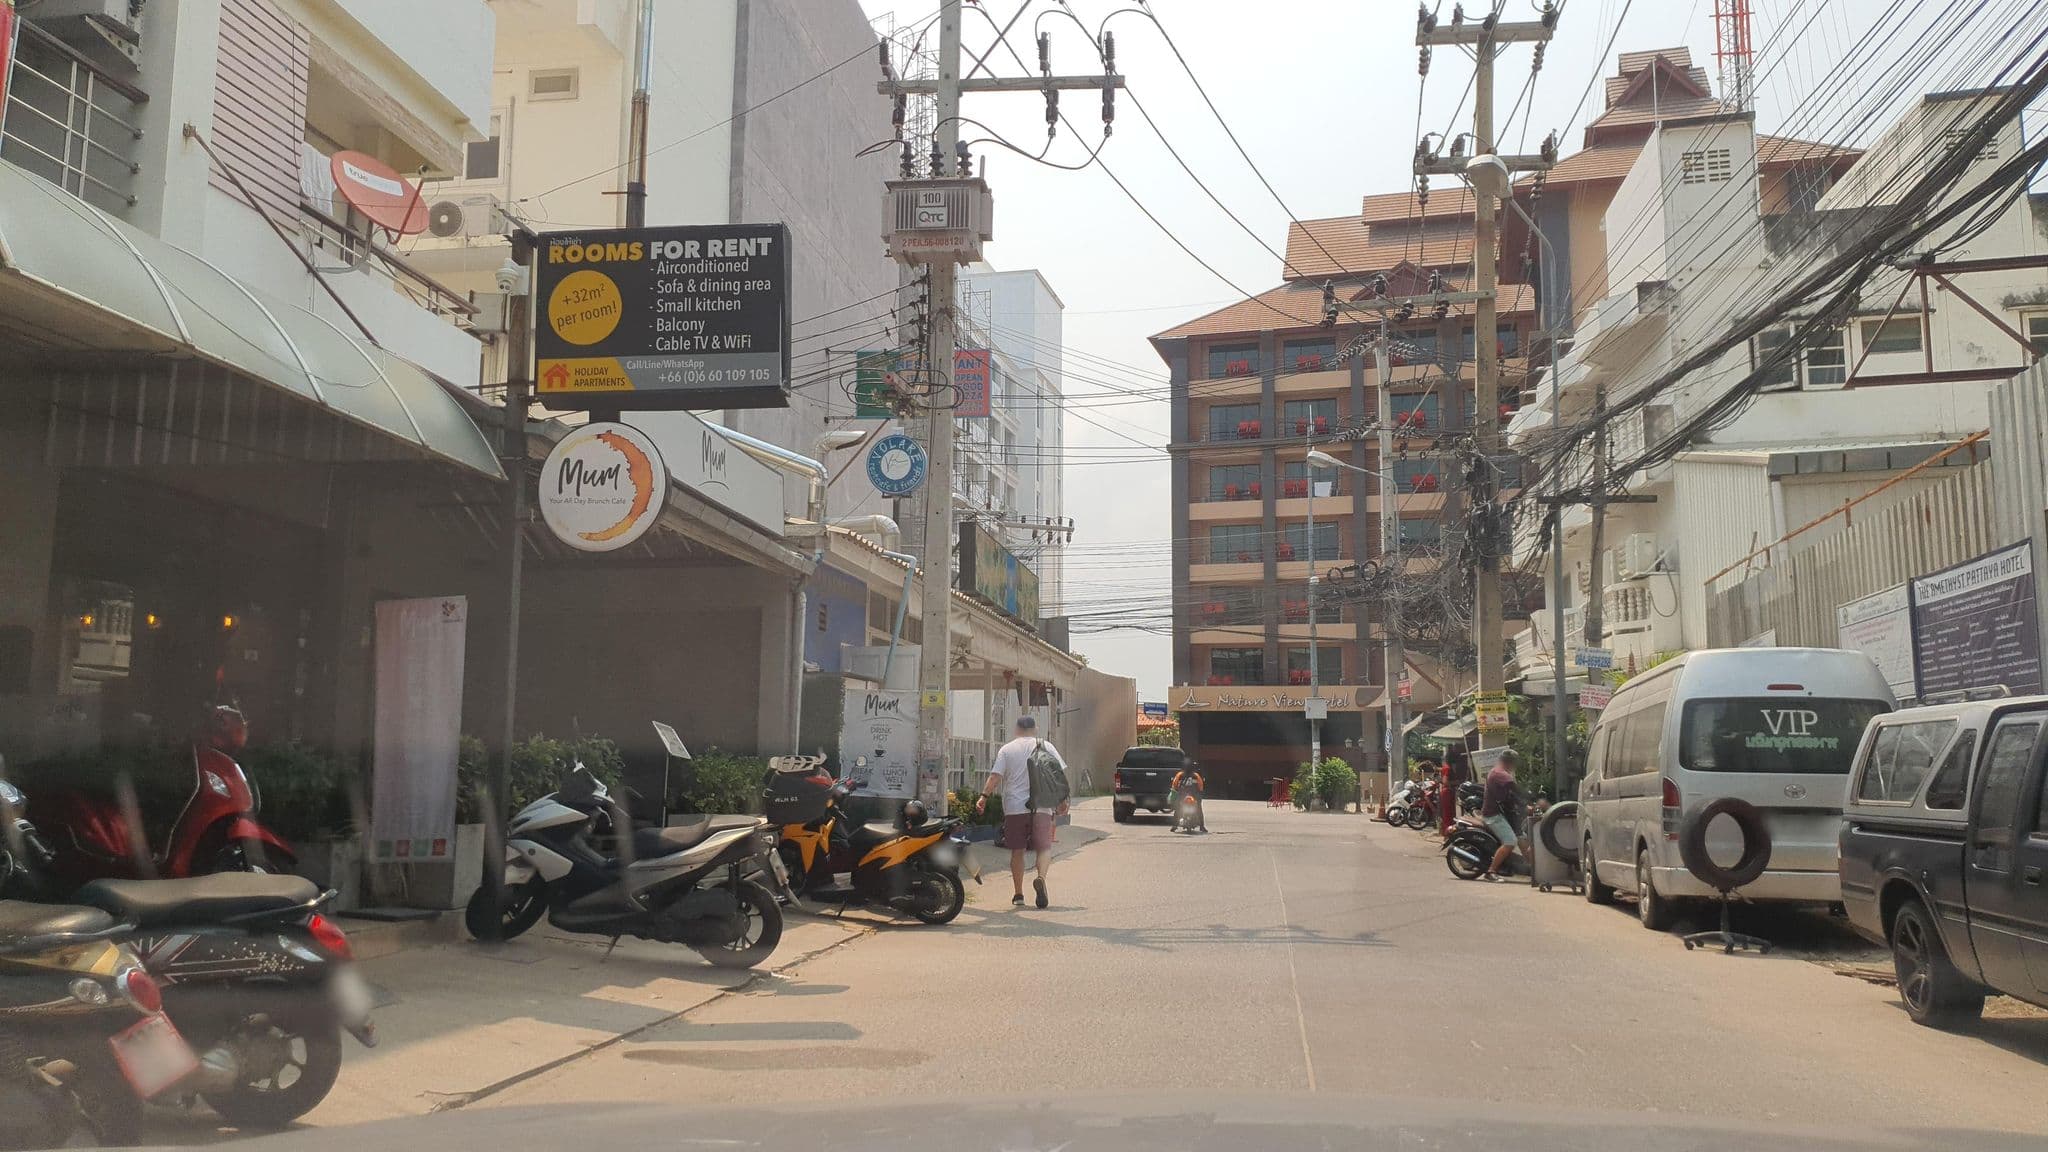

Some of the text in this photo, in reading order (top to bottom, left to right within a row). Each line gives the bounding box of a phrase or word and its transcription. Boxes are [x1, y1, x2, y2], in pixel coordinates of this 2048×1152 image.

[923, 192, 941, 204] 100
[918, 210, 944, 224] QTC
[548, 237, 772, 264] ROOMS FOR RENT
[657, 257, 749, 275] Airconditioned
[657, 275, 771, 296] Sofa & dining area
[657, 296, 741, 313] Small kitchen
[556, 300, 618, 332] per room!
[656, 317, 705, 335] Balcony
[656, 334, 752, 352] Cable TV & WiFi
[574, 366, 609, 377] HOLIDAY
[626, 359, 705, 371] Call/Line/WhatsApp
[574, 377, 626, 388] APARTMENTS
[658, 368, 770, 384] +66 (0)6 60 109 105
[701, 430, 727, 479] Mum
[872, 439, 922, 463] VOLARE
[558, 457, 621, 497] Mum
[549, 497, 563, 506] Your
[564, 497, 573, 505] All
[574, 497, 587, 507] Day
[587, 497, 610, 506] Brunch
[1919, 554, 2025, 600] THE AMETHYST PATTAYA HOTEL
[864, 694, 900, 716] Mum
[1216, 694, 1268, 709] Nature
[1272, 693, 1306, 709] View
[1760, 709, 1818, 735] VIP
[883, 768, 907, 776] LUNCH
[886, 776, 904, 784] WELL
